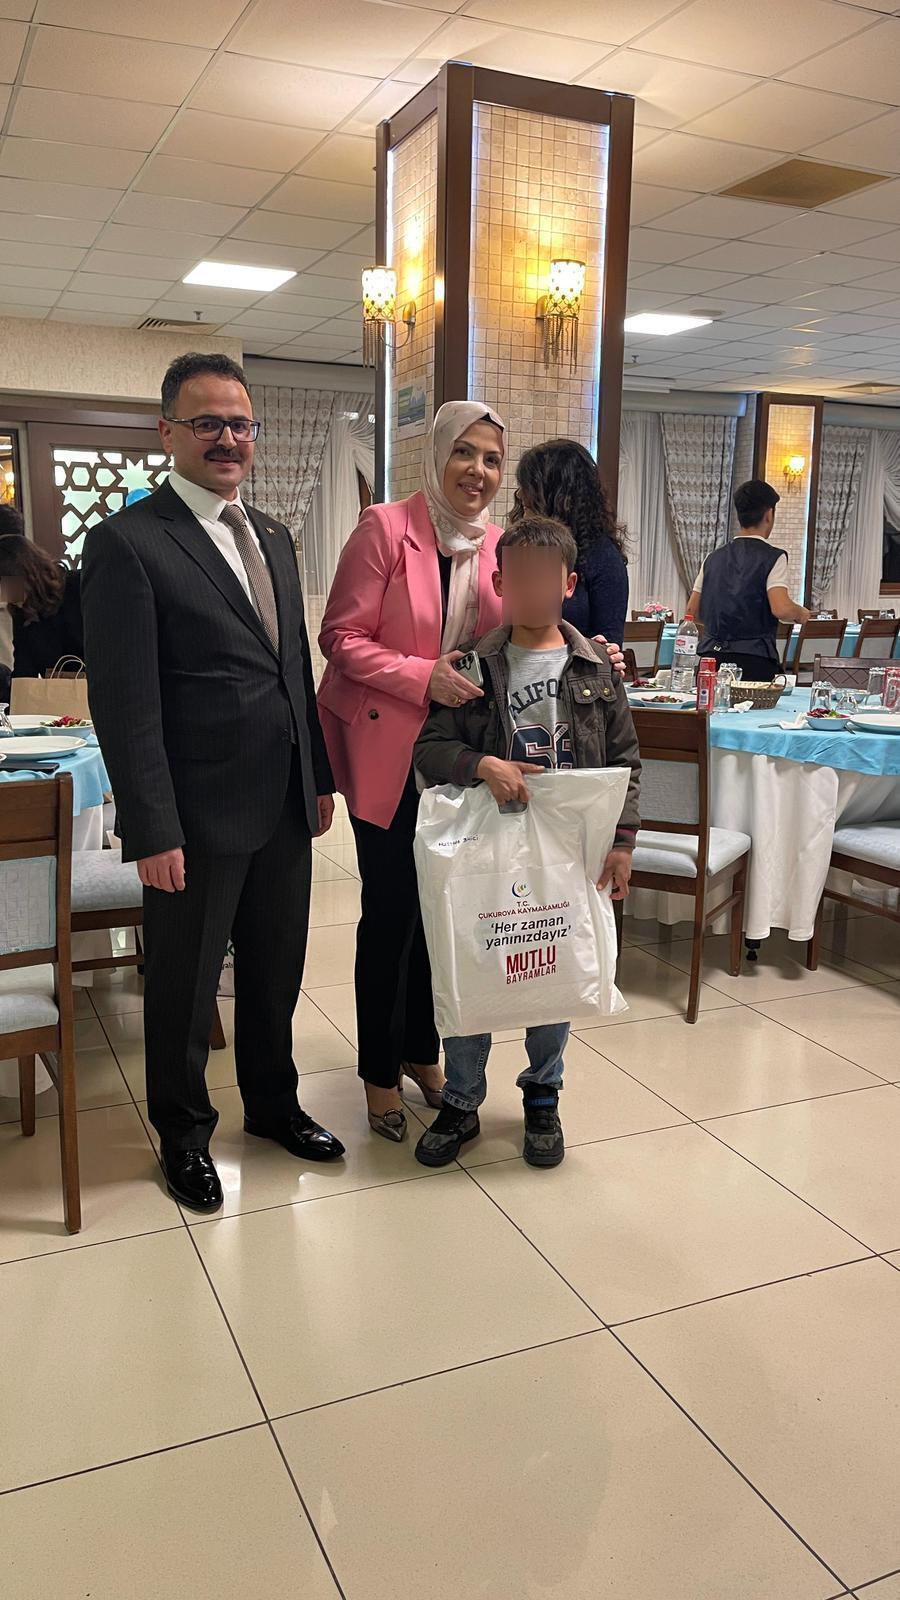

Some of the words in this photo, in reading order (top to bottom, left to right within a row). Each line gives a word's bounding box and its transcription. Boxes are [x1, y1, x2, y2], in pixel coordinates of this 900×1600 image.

[478, 909, 516, 920] ÇUKUROVA
[518, 902, 570, 914] KAYMAKAMLIĞI
[521, 916, 564, 931] zaman
[506, 945, 556, 975] MUTLU
[506, 964, 556, 985] BAYRAMLAR
